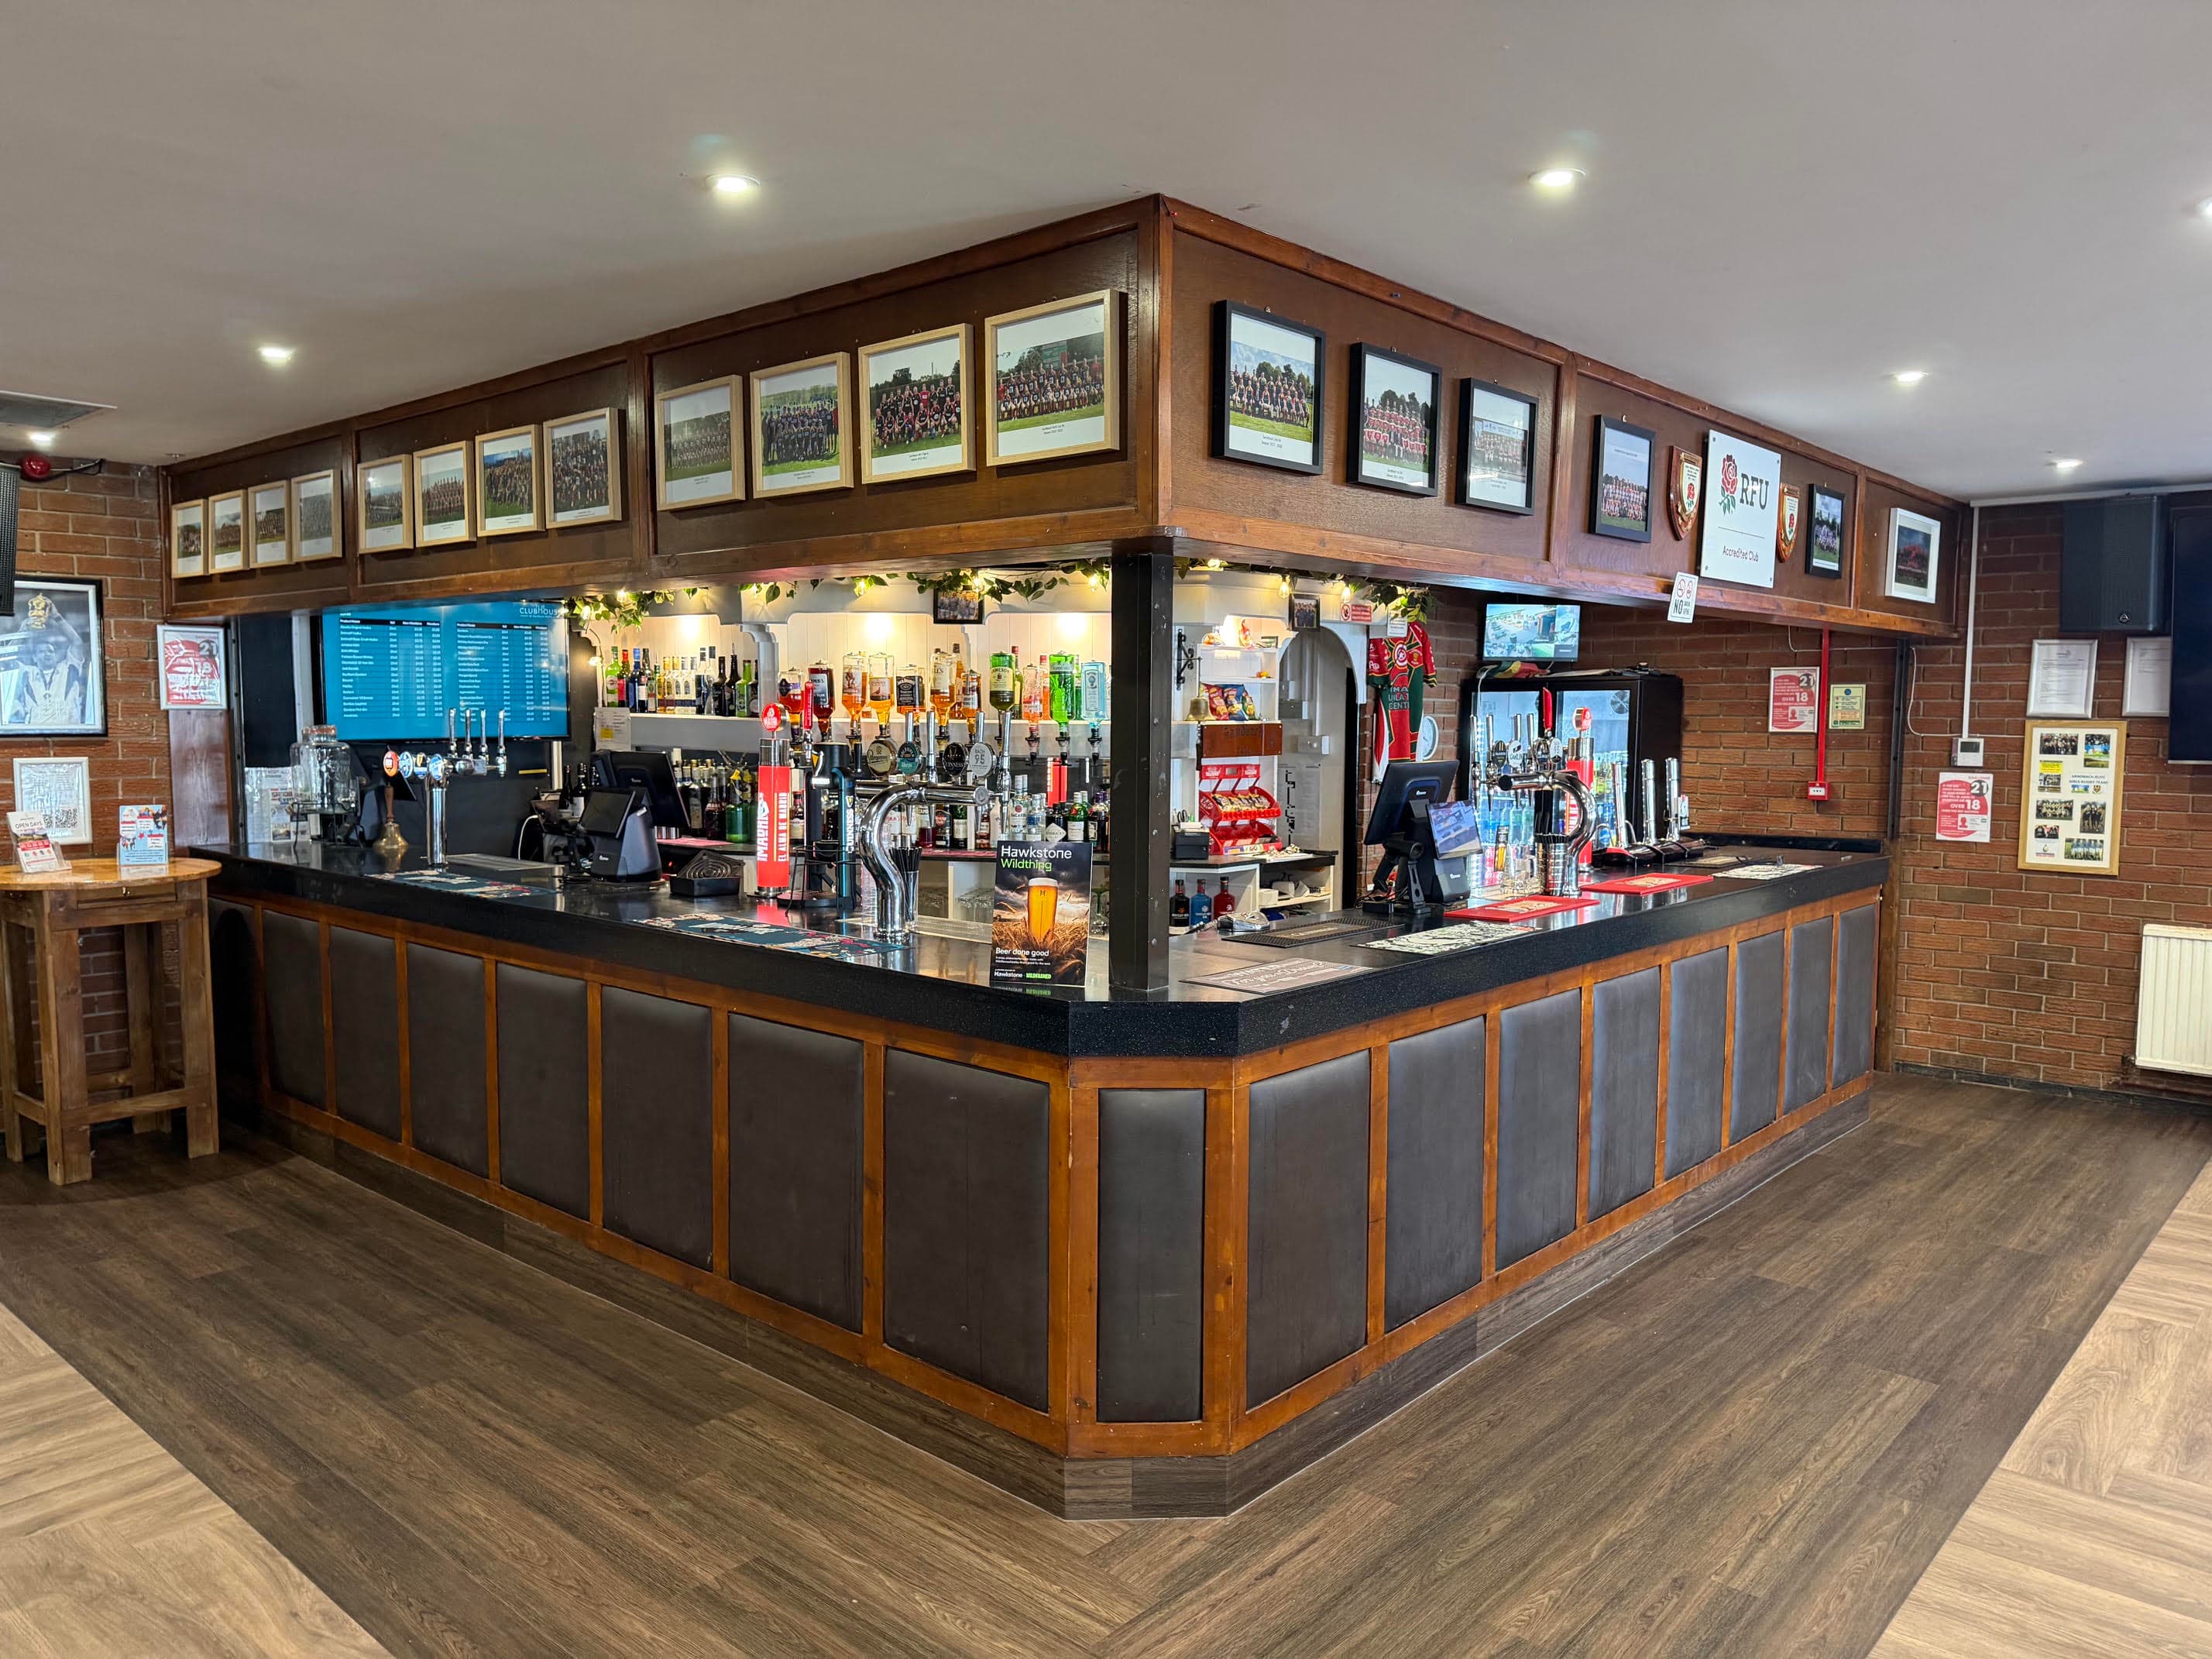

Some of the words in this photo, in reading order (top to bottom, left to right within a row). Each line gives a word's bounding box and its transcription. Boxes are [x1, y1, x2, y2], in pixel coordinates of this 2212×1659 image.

[1740, 473, 1769, 510] RFU
[1723, 545, 1748, 561] Accredited
[1748, 550, 1759, 562] Club
[520, 606, 560, 615] CLUBHOUS
[1673, 599, 1684, 614] NO
[199, 642, 218, 657] 21
[1799, 675, 1814, 686] 21
[1795, 692, 1808, 702] 18
[974, 754, 985, 764] 95
[1970, 781, 1987, 794] 21
[778, 792, 787, 819] MADRID
[1966, 799, 1980, 810] 18
[778, 821, 787, 830] DE
[778, 833, 787, 852] ALMA
[1001, 845, 1072, 859] Hawkstone
[1001, 859, 1053, 871] Wildthing
